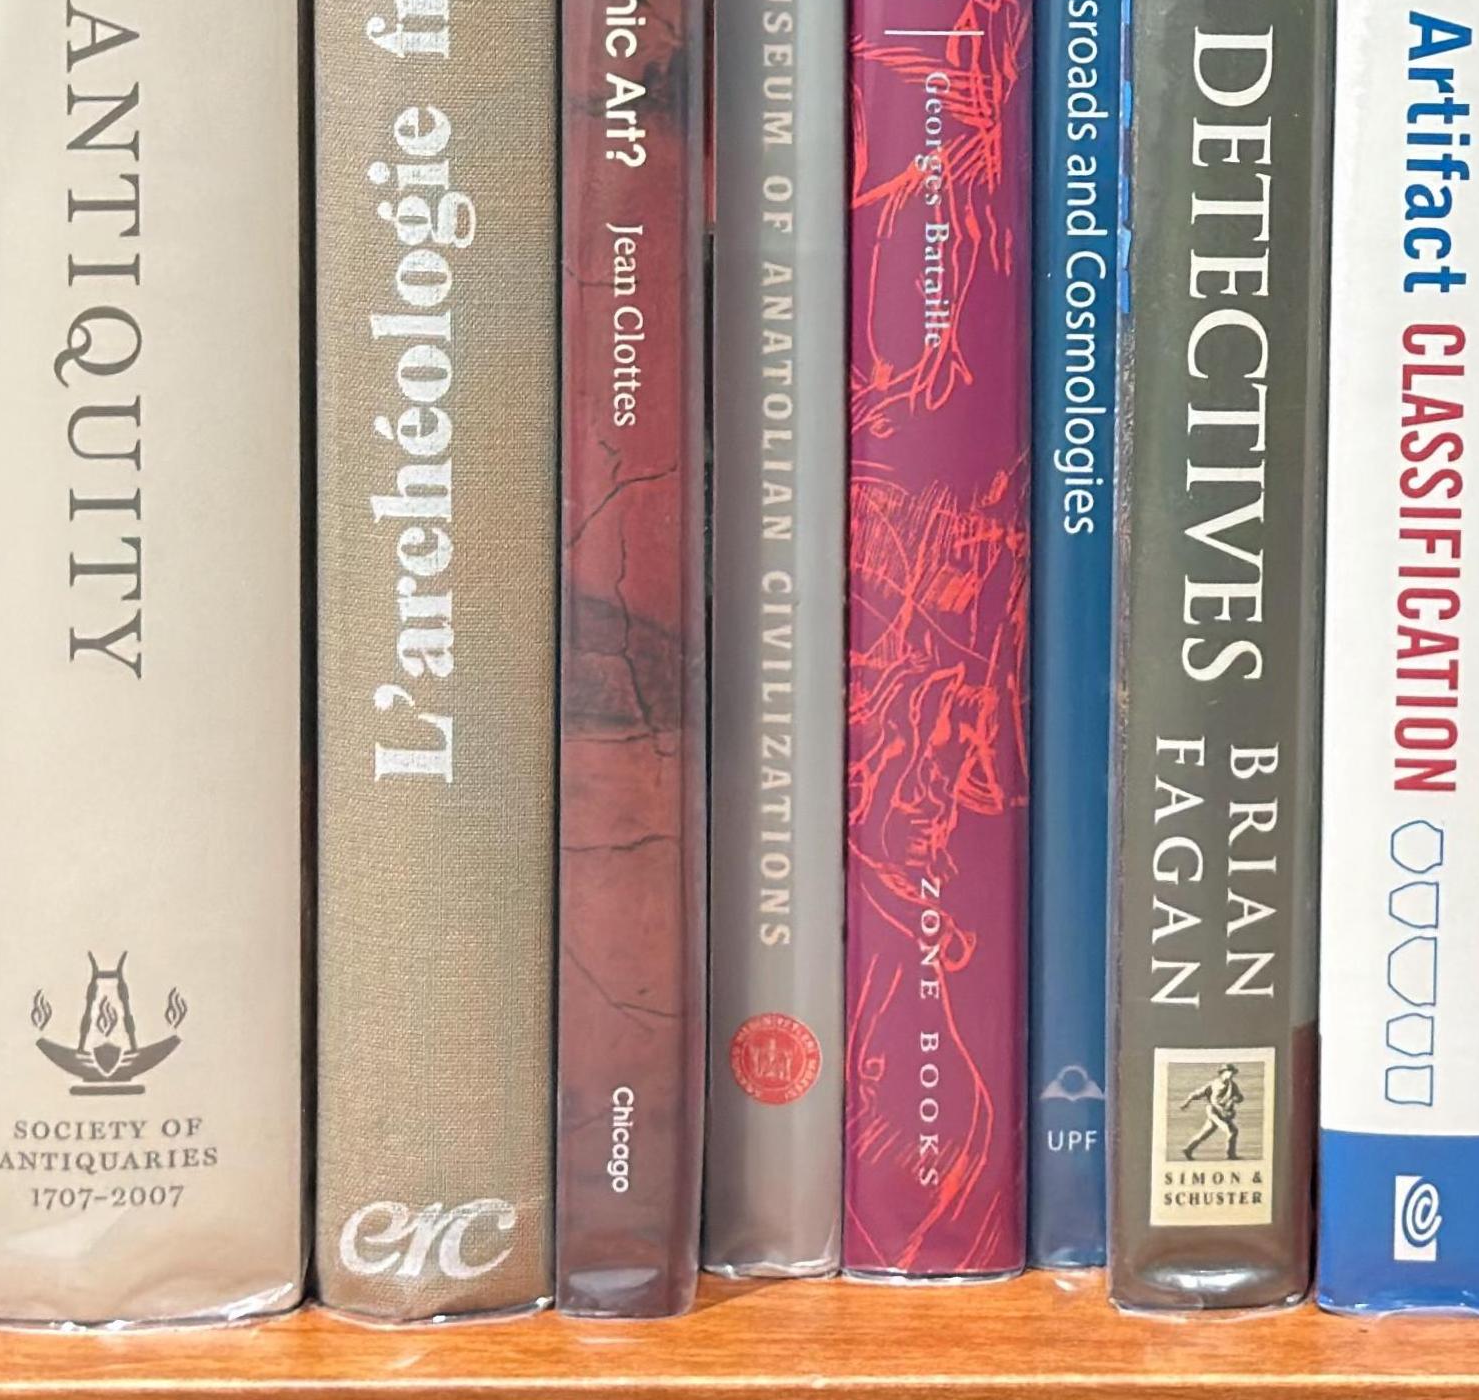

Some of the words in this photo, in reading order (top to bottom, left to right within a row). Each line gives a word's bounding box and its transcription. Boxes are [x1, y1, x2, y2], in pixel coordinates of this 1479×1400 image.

[606, 72, 646, 169] Art?
[914, 71, 951, 207] Georges
[1402, 10, 1472, 293] Artifact
[763, 176, 792, 234] OF
[1067, 149, 1107, 237] and
[606, 223, 644, 295] Jean
[924, 221, 951, 348] Bataille
[52, 0, 142, 679] ANTIQUITY
[613, 308, 644, 427] Clottes
[762, 262, 793, 541] ANATOLIAN
[1055, 252, 1106, 535] Cosmologies
[1182, 24, 1274, 682] DETECTIVES
[367, 105, 476, 783] L'archéologie
[1393, 322, 1467, 792] CLASSIFICATION
[759, 572, 792, 946] CIVILIZATIONS
[1151, 737, 1205, 1009] FAGAN
[1225, 745, 1279, 998] BRIAN
[919, 878, 939, 999] ZONE
[13, 1117, 147, 1142] SOCIETY
[161, 1116, 203, 1137] OF
[607, 1086, 633, 1193] Chicago
[919, 1032, 939, 1188] BOOKS
[1047, 1130, 1098, 1151] UPF
[1163, 1190, 1262, 1205] SCHUSTER
[1165, 1171, 1241, 1184] SIMON
[1251, 1170, 1262, 1183] &
